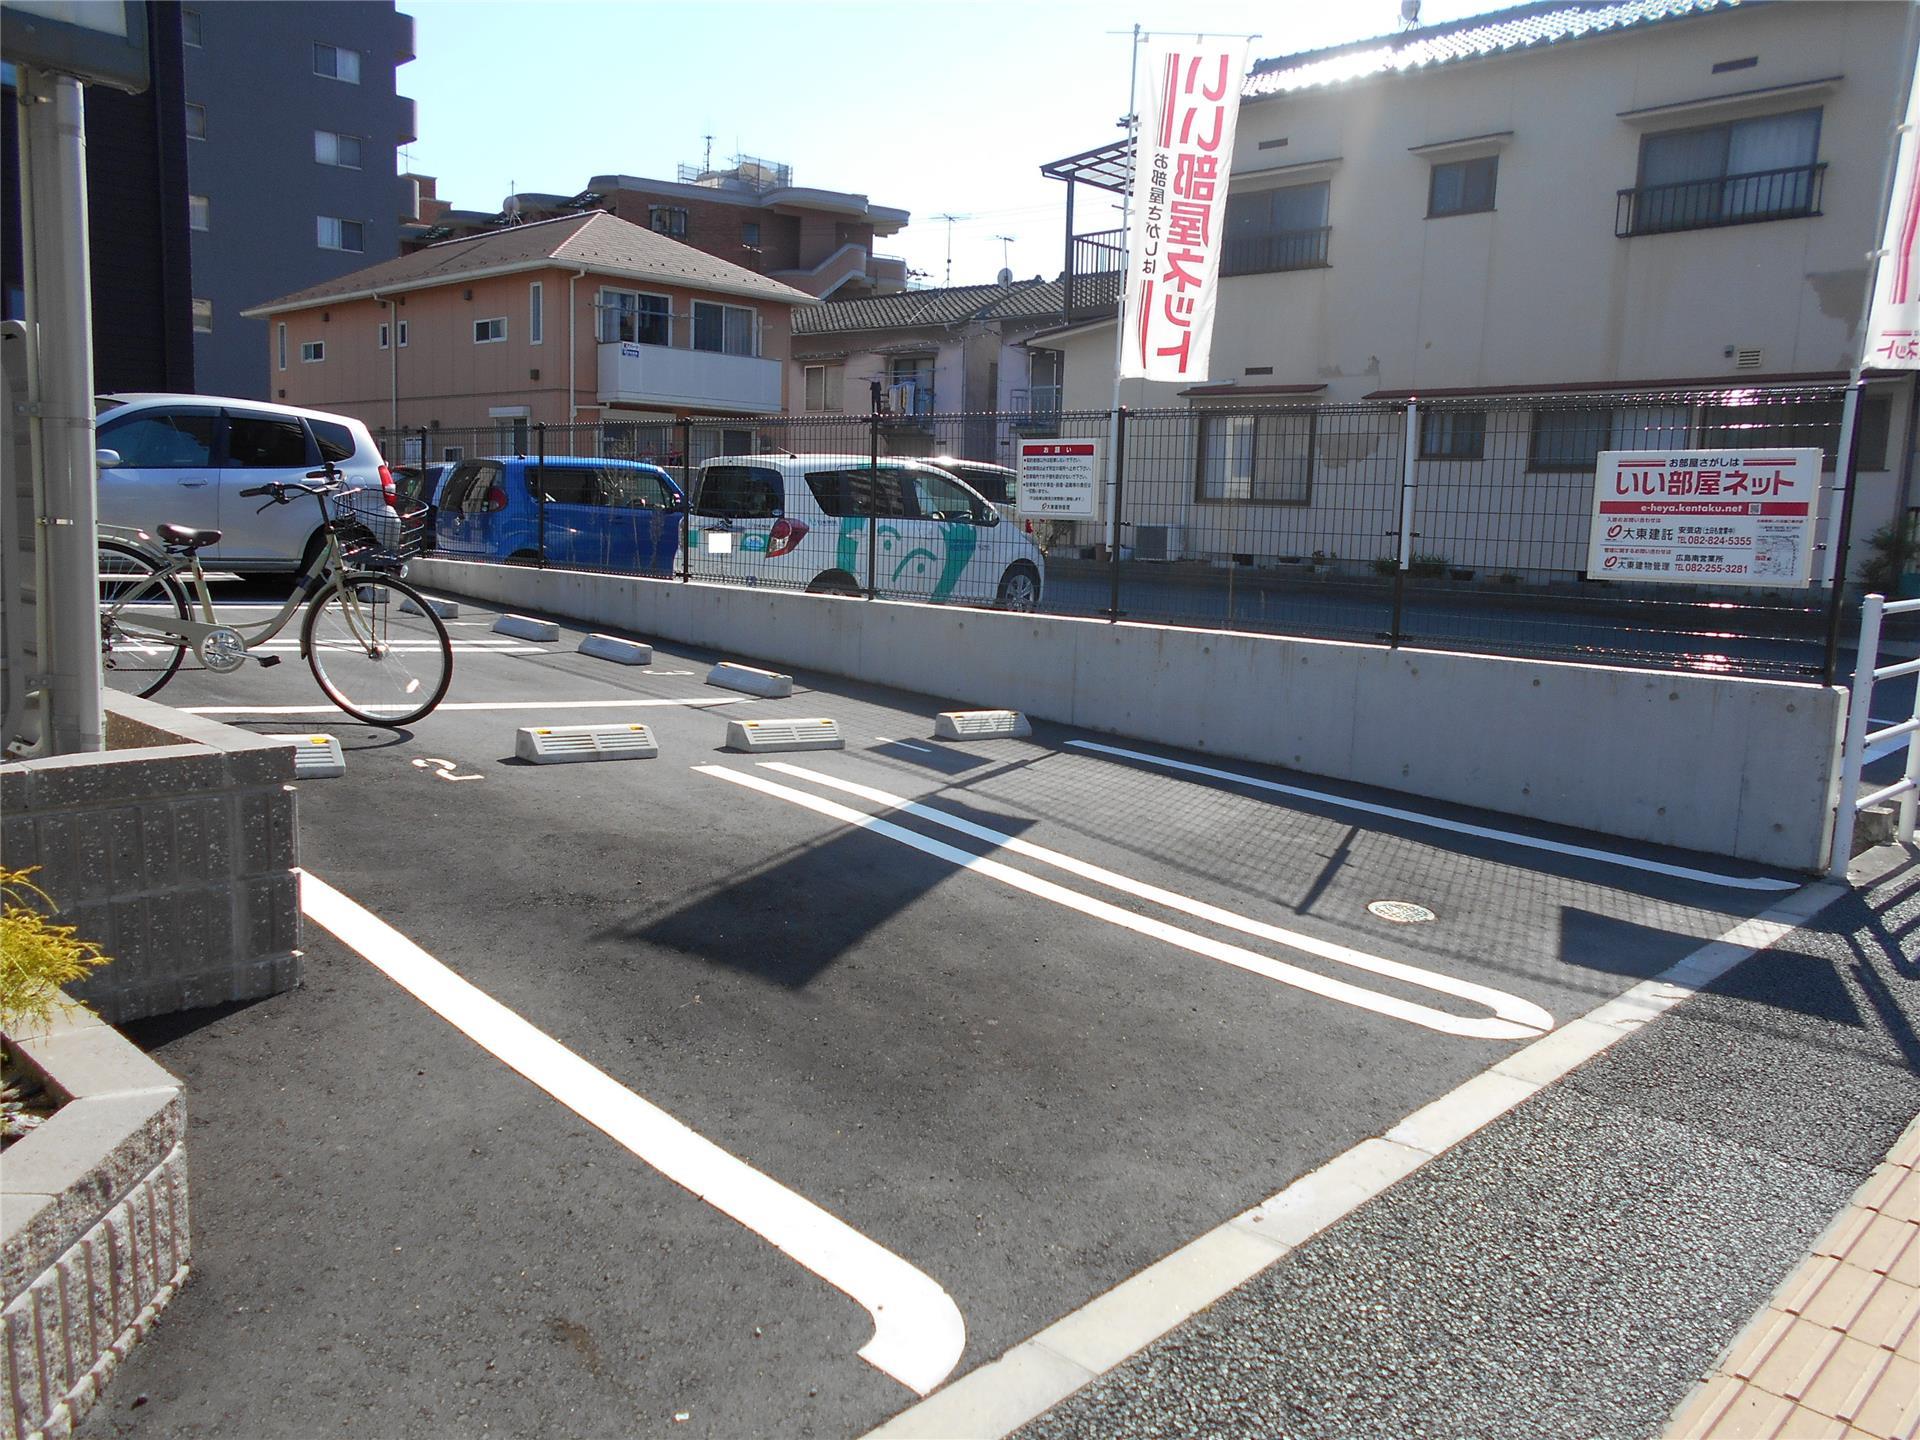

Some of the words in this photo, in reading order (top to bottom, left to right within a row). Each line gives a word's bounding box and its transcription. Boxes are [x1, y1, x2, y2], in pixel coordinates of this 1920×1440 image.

[1668, 457, 1740, 468] お部屋さがしは
[1615, 470, 1795, 496] いい部屋ネット
[1641, 503, 1743, 514] e-heya.kentaku.net
[1623, 527, 1673, 541] 大東建託
[1677, 536, 1687, 545] TEL
[1688, 535, 1752, 546] 082-824-5355
[1675, 554, 1724, 563] 広島南営業所
[1617, 560, 1671, 571] 大東建物管理
[1675, 563, 1685, 572] TEL
[1685, 563, 1748, 574] 082-255-3281
